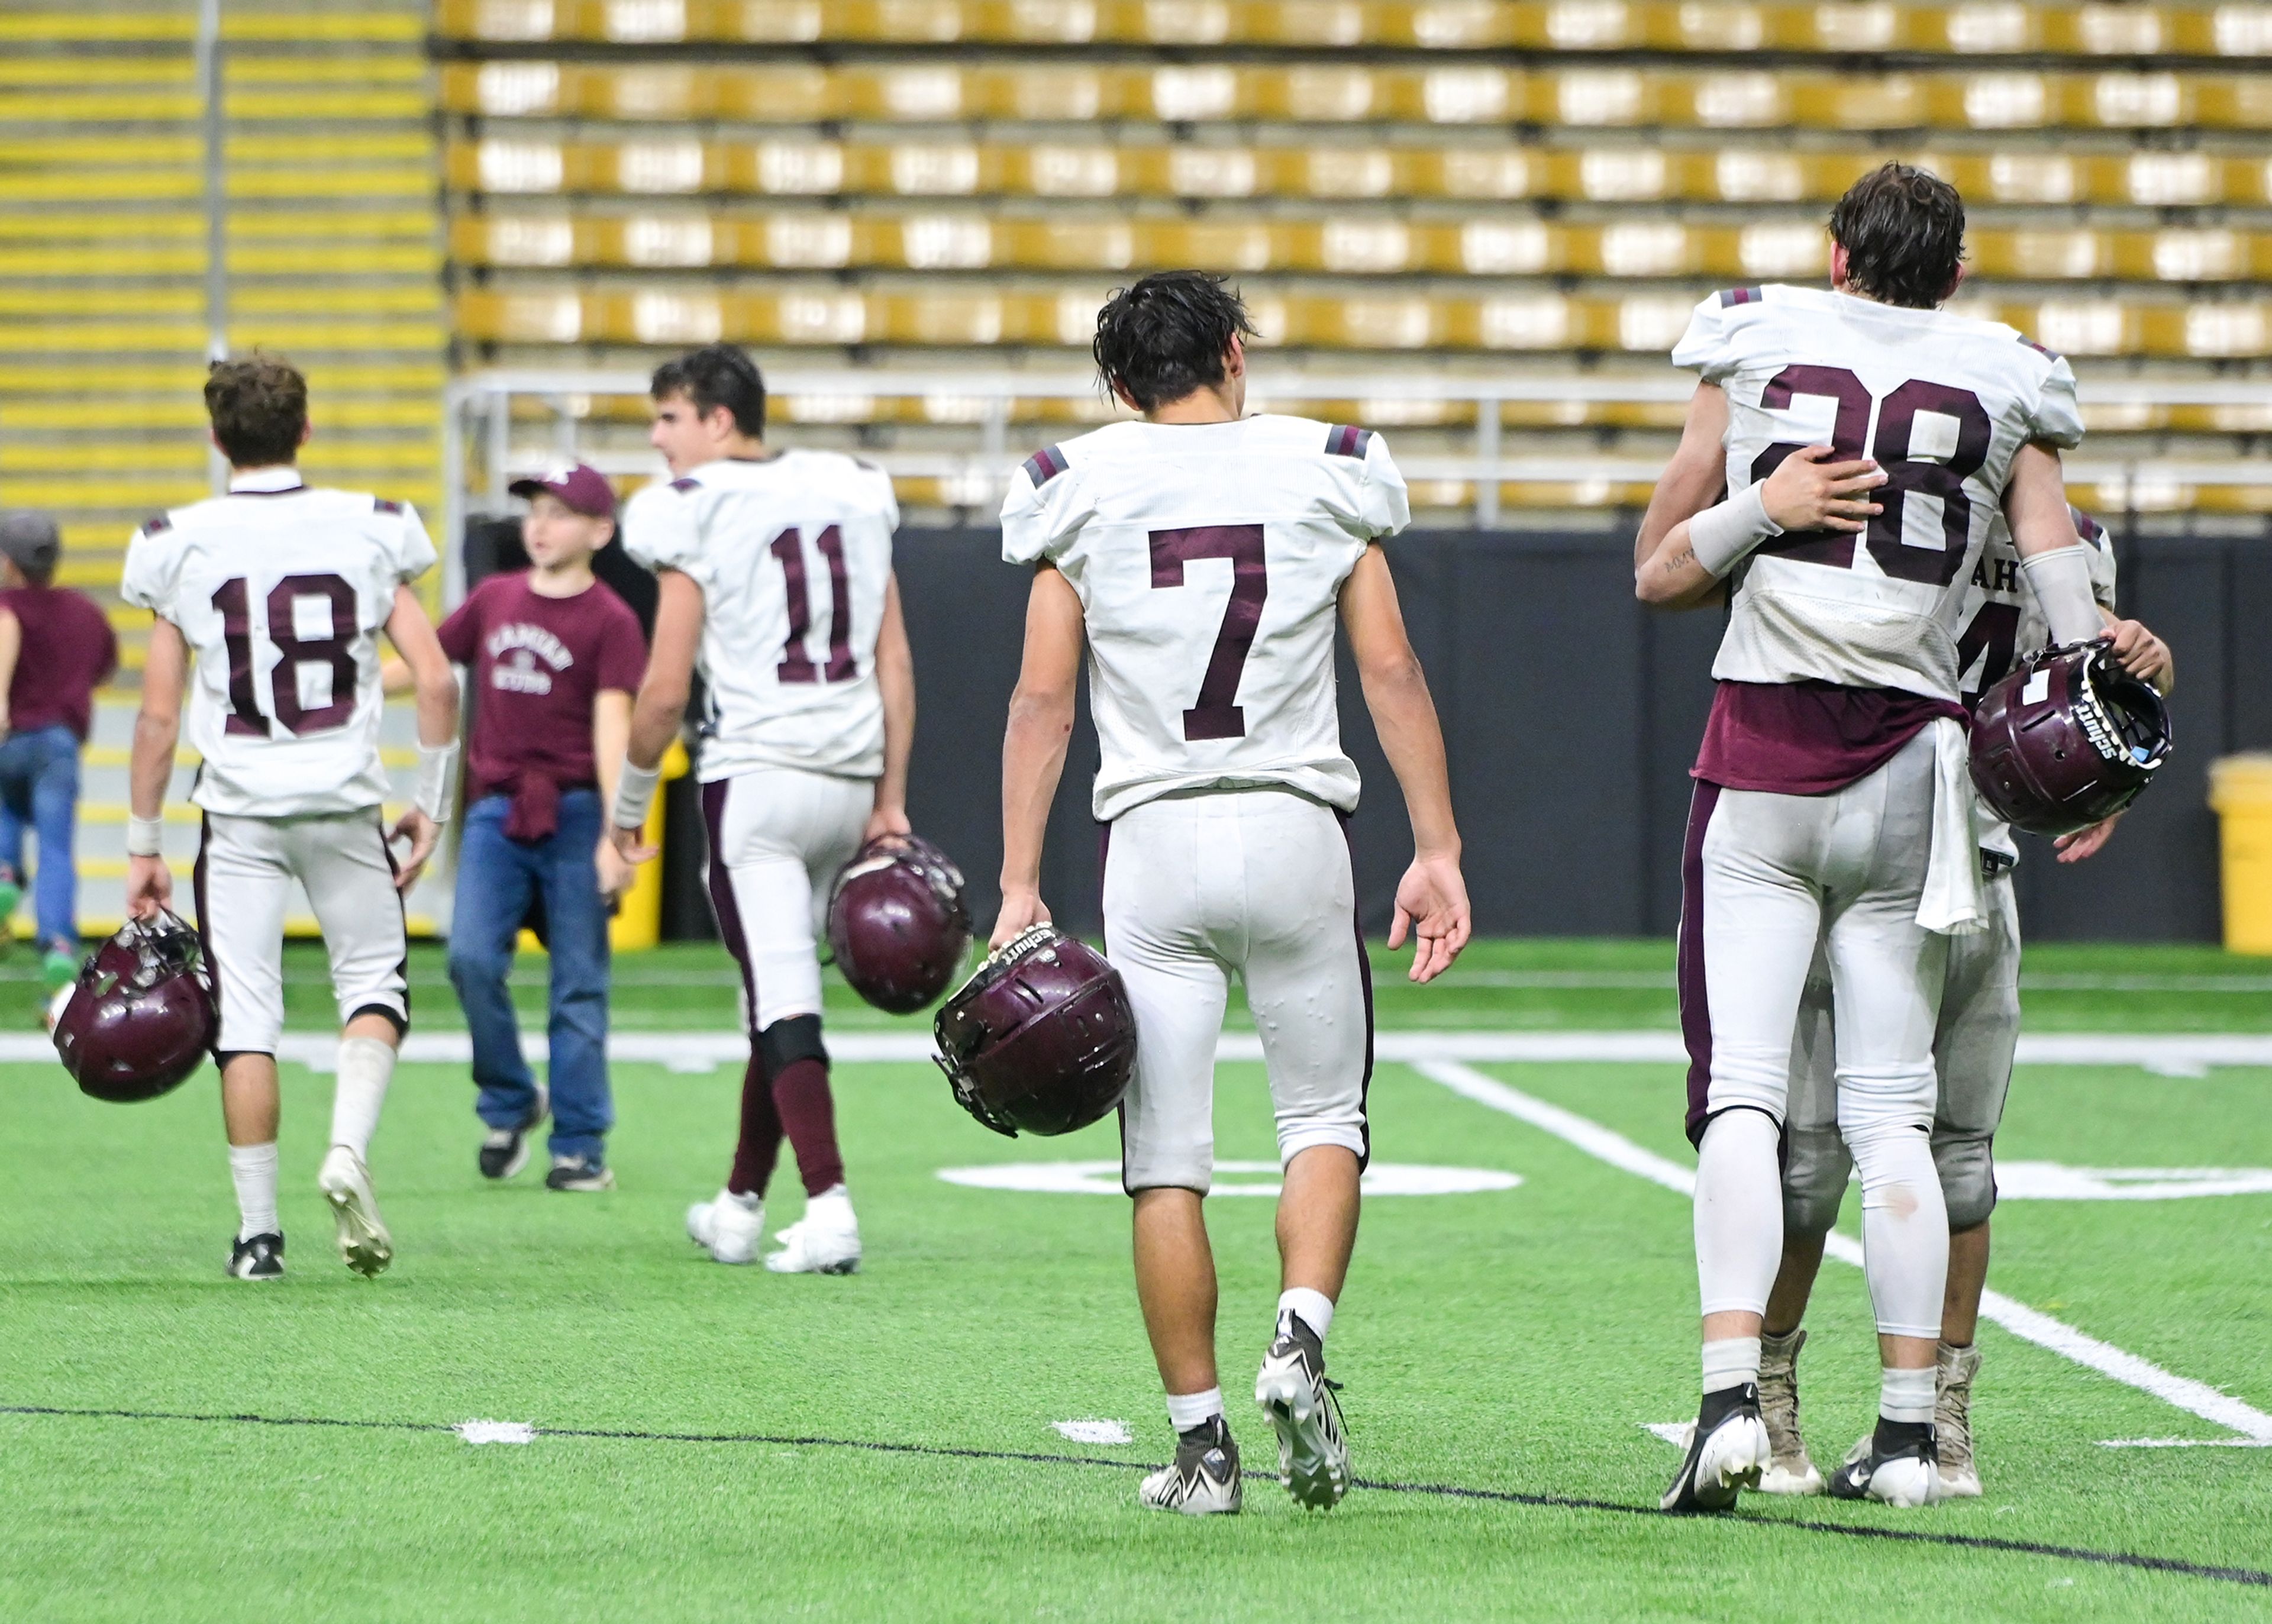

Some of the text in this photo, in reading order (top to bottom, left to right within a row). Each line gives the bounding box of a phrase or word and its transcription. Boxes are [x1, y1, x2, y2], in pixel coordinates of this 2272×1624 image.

[1750, 364, 1992, 587] 28
[211, 573, 359, 738] 18
[770, 524, 857, 683] 11
[1148, 524, 1267, 741] 7
[1002, 929, 1052, 966] schutt
